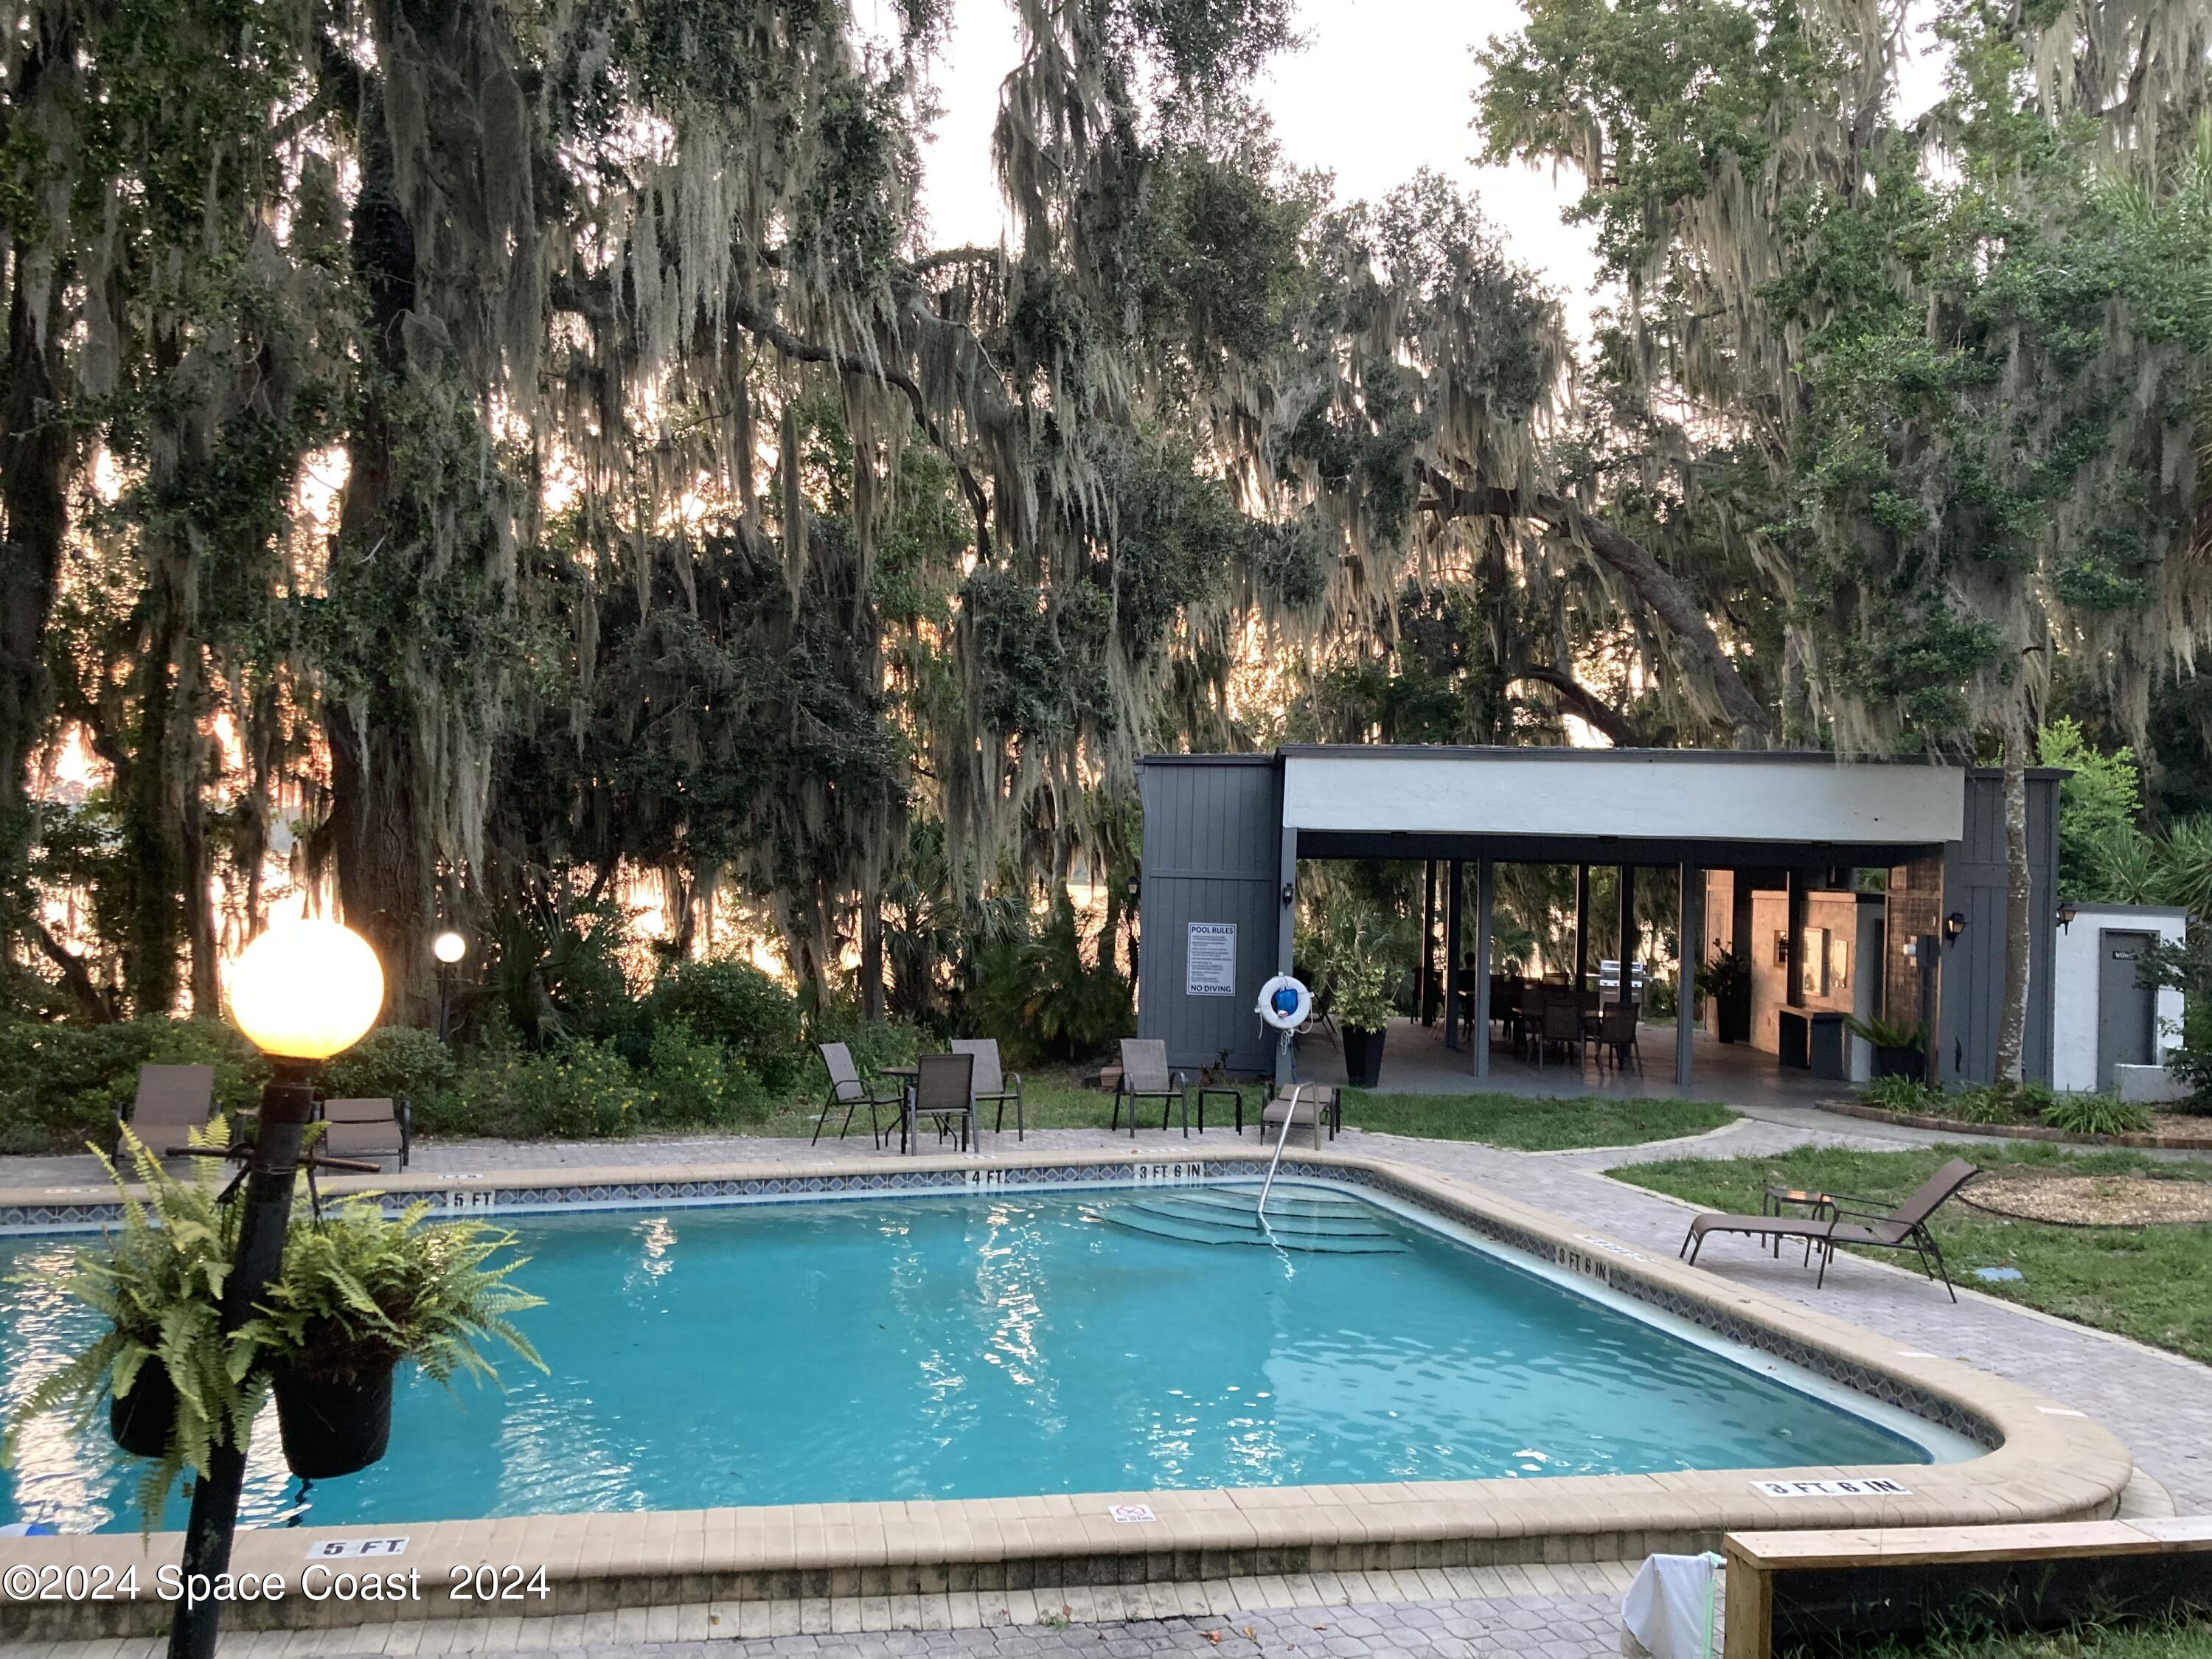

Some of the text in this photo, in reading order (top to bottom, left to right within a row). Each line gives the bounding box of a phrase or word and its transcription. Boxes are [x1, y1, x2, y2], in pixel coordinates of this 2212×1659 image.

[972, 1171, 981, 1184] 4
[1140, 1166, 1147, 1178] 3
[1174, 1164, 1181, 1177] 6
[454, 1192, 464, 1206] 5
[1559, 1248, 1565, 1265] 3
[1585, 1258, 1591, 1274] 6
[1765, 1483, 1789, 1494] 3
[1837, 1481, 1860, 1493] 6
[323, 1543, 347, 1555] 5
